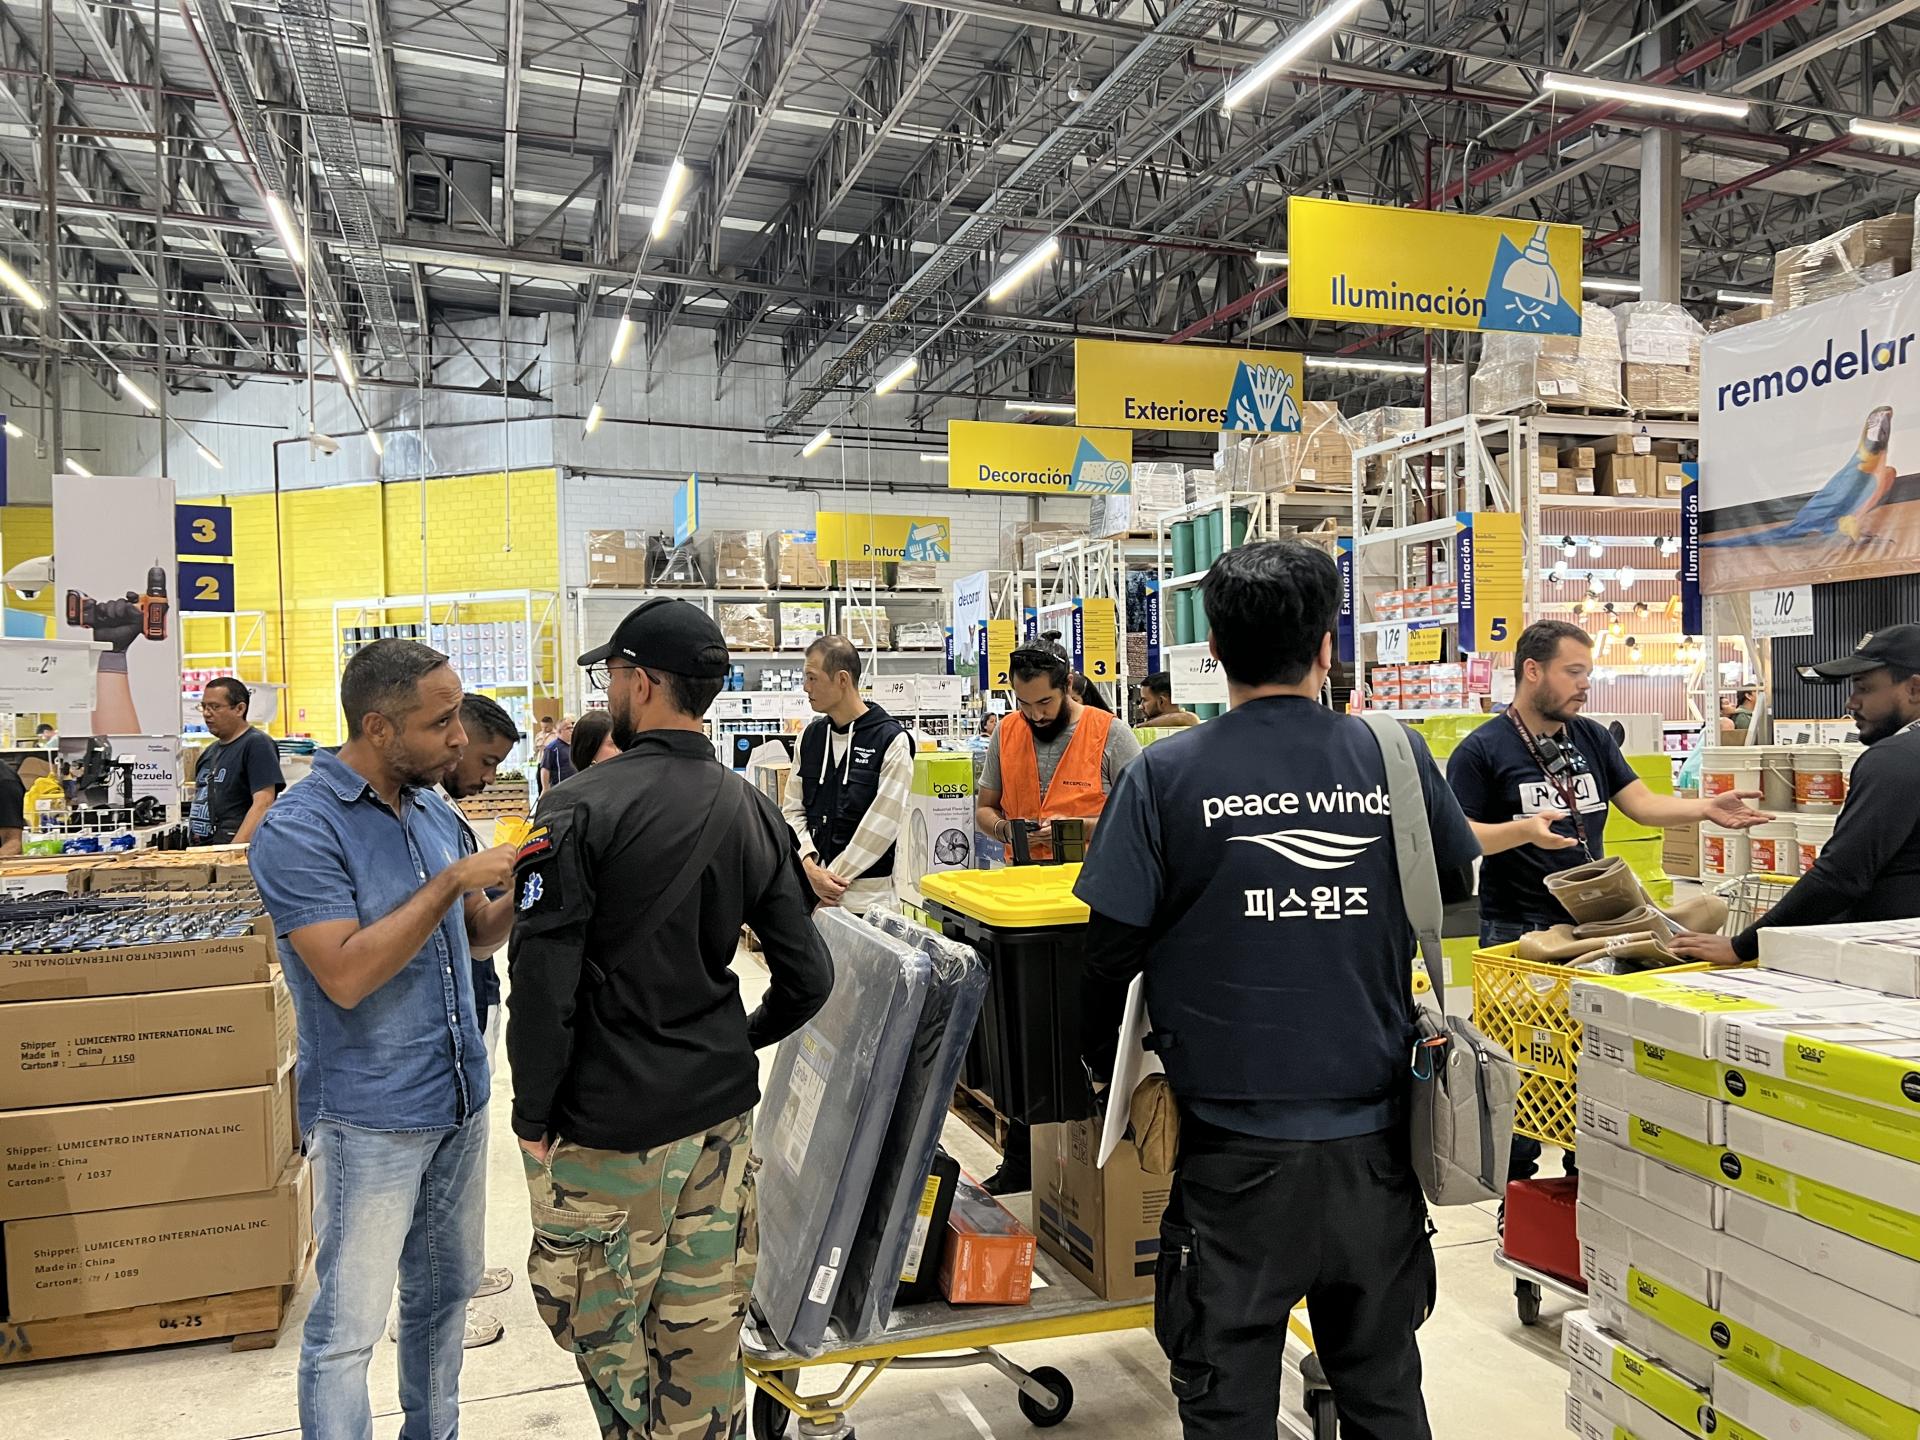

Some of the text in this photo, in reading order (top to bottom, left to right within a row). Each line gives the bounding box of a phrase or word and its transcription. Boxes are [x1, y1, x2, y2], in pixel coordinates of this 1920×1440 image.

[1331, 275, 1487, 317] Iluminación
[1718, 329, 1915, 411] remodelar
[1124, 397, 1228, 424] Exteriores
[979, 464, 1072, 486] Decoración
[192, 518, 216, 543] 3
[1685, 494, 1698, 582] Iluminación
[863, 544, 906, 557] Pntura
[1461, 538, 1471, 609] Iluminación
[195, 576, 219, 600] 2
[1342, 560, 1350, 615] Exteriores
[1774, 590, 1794, 616] 110
[1490, 618, 1507, 641] 5
[1094, 661, 1106, 675] 3
[1200, 658, 1218, 673] 139
[998, 672, 1008, 684] 2
[116, 769, 173, 780] Vnezuela
[1202, 784, 1391, 827] peace winds
[1244, 886, 1369, 921] 피스윈즈
[8, 945, 244, 969] Shipper: LUMICENTRO INTERNATIONAL INC.
[21, 1040, 56, 1051] Shipper
[75, 1033, 135, 1046] LUMICENTRO
[138, 1027, 214, 1041] INTERNATIONAL
[216, 1025, 235, 1035] INC.
[1644, 1041, 1665, 1057] basc
[21, 1051, 45, 1061] Made
[51, 1049, 60, 1057] in
[77, 1047, 102, 1056] China
[21, 1060, 58, 1071] Carton#
[112, 1054, 135, 1064] 1150
[1531, 1043, 1566, 1069] EPA
[1797, 1043, 1826, 1059] basc
[6, 1123, 244, 1156] Shipper: LUMICENTRO INTERNATIONAL INC.
[7, 1161, 36, 1171] Made
[40, 1160, 49, 1168] in
[58, 1157, 88, 1166] China
[87, 1170, 112, 1179] 1037
[34, 1219, 269, 1258] Shipper: LUMICENTRO INTERNATIONAL INC.
[35, 1263, 64, 1274] Made
[67, 1261, 77, 1270] in
[85, 1258, 115, 1268] China
[114, 1269, 139, 1279] 1089
[159, 1315, 202, 1329] 04-25
